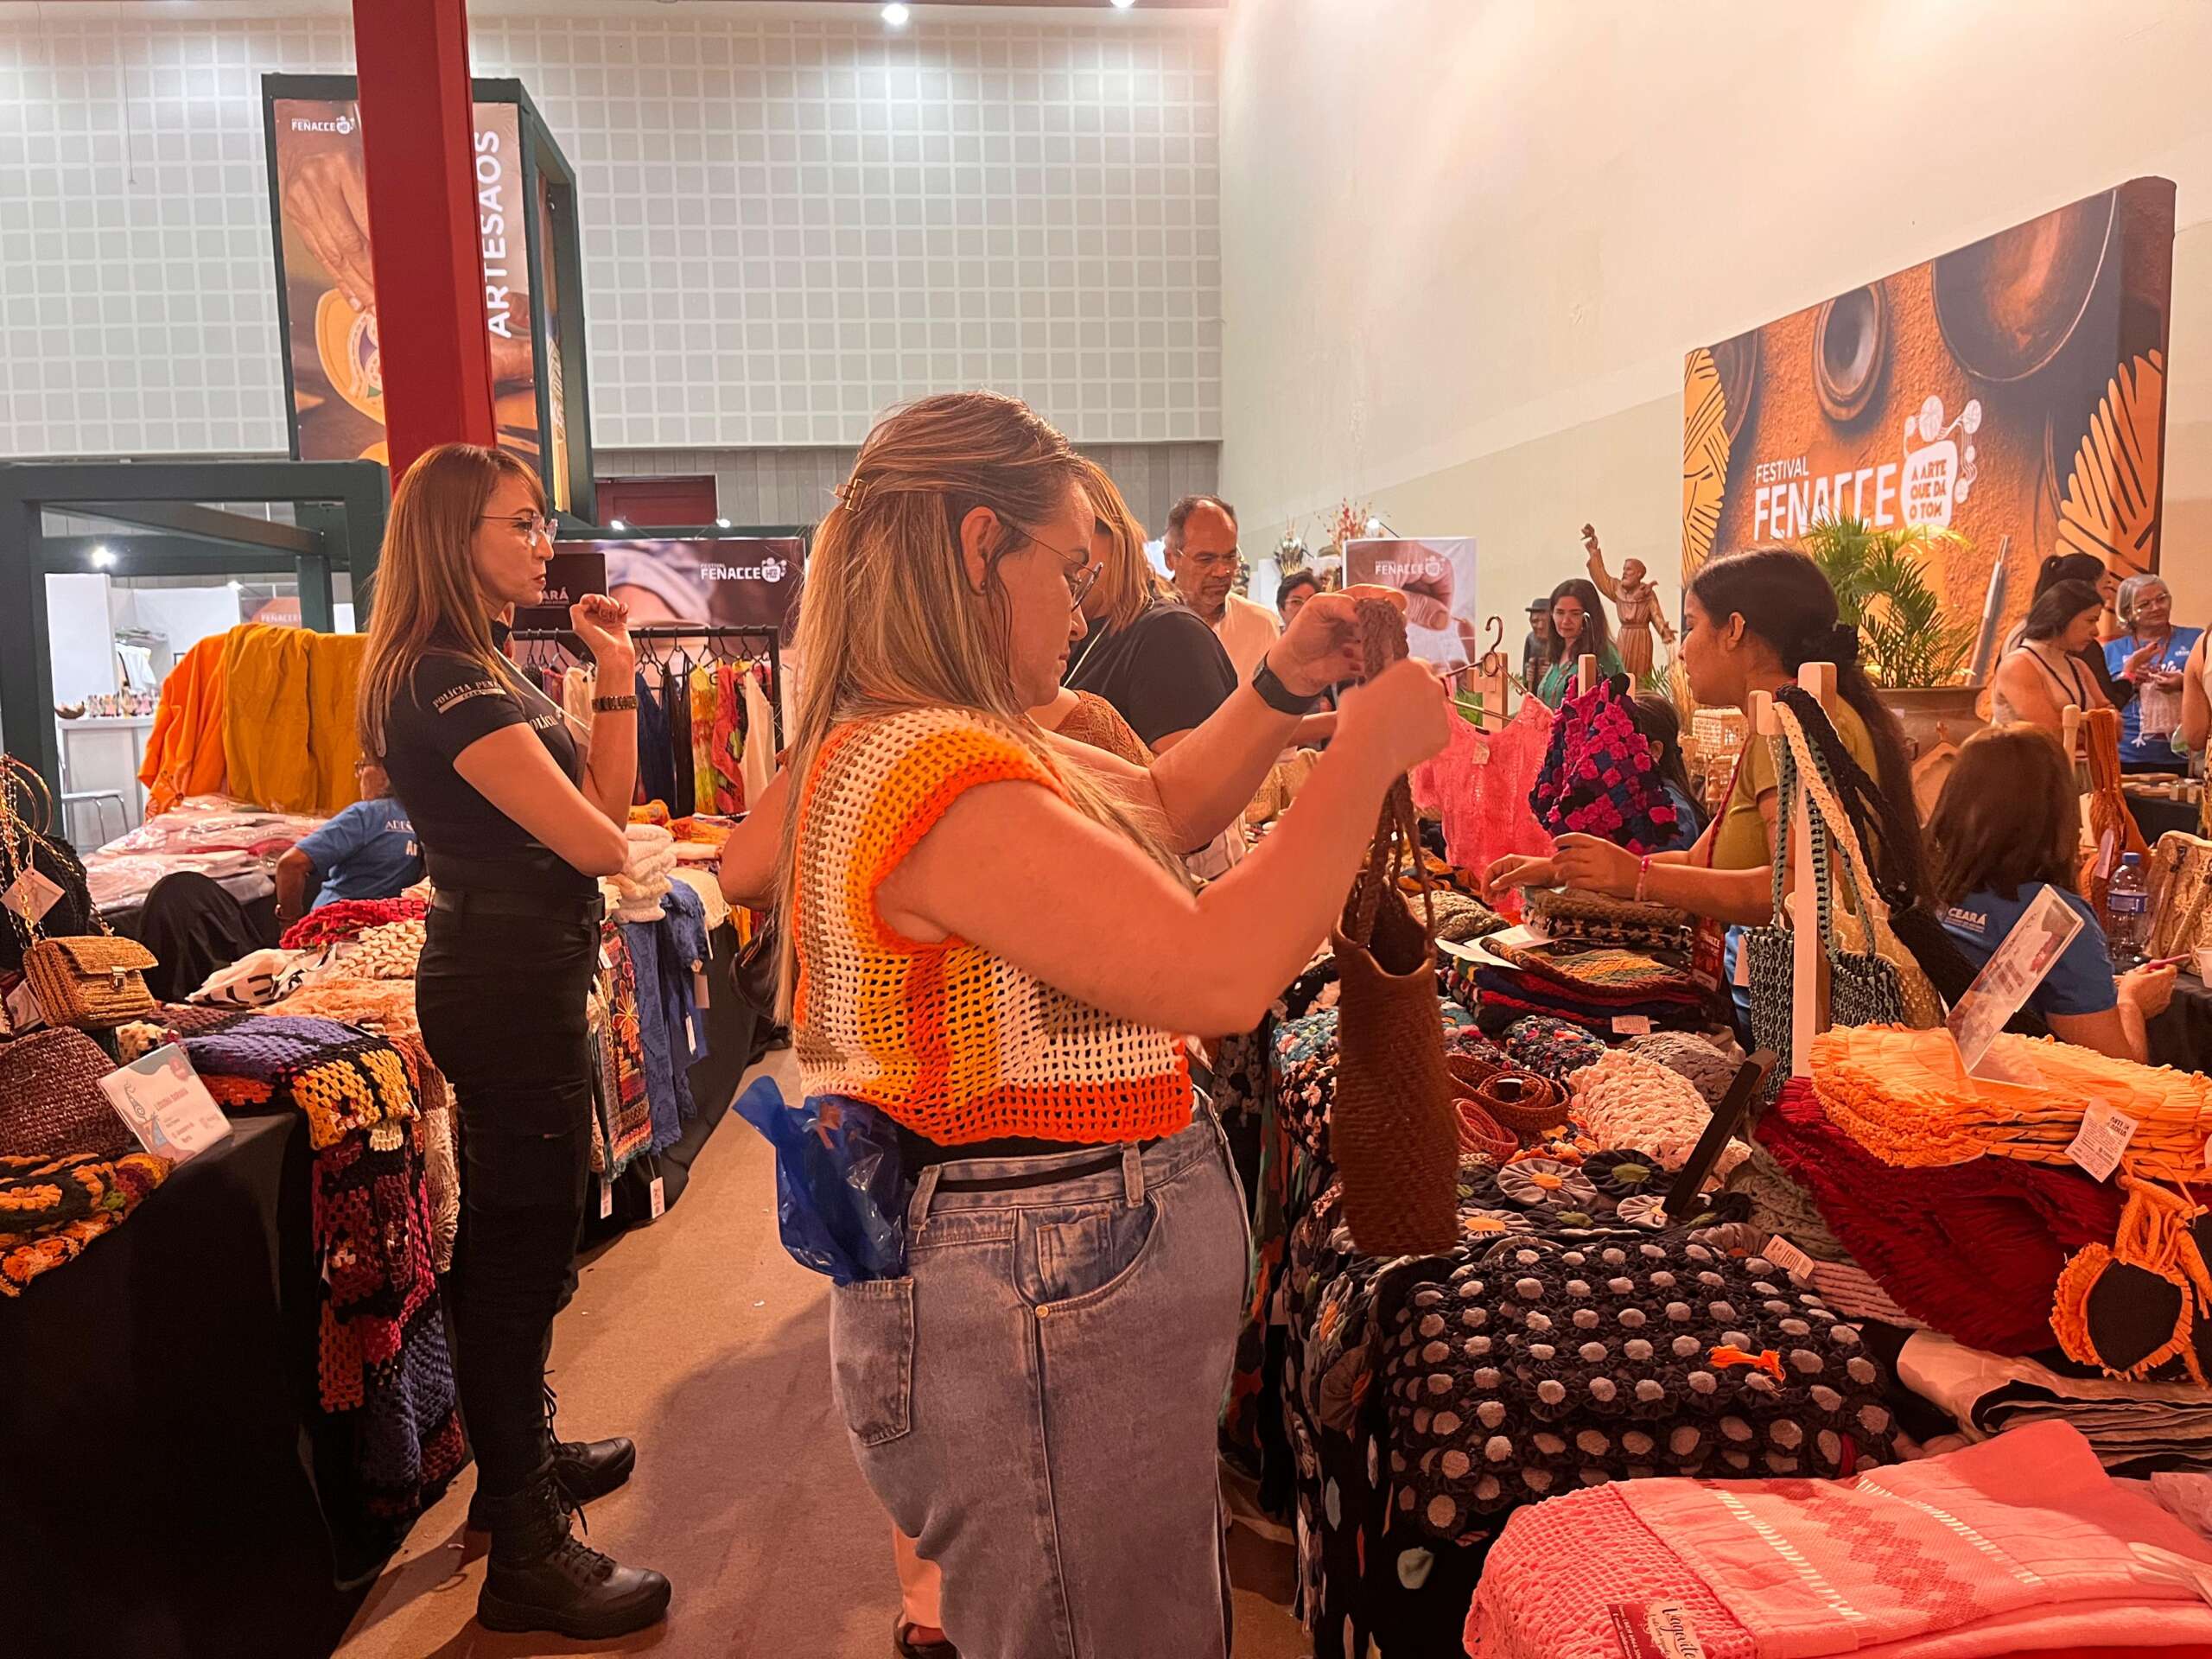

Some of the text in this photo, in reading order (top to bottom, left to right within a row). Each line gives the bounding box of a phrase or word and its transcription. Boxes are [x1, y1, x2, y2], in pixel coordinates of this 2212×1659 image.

[291, 121, 336, 131] FENACCE
[1755, 456, 1810, 484] FESTIVAL
[1911, 459, 1947, 481] A ARTE
[1910, 482, 1931, 500] QUE
[1753, 462, 1897, 542] FENACCE
[1909, 501, 1942, 520] O TOM
[701, 567, 761, 580] FENACCE
[1375, 563, 1424, 575] FENACCE
[543, 587, 569, 601] ARÁ
[432, 683, 472, 708] POLÍCIA
[529, 714, 558, 731] OLÍCIA
[1948, 907, 1987, 927] CEARÁ
